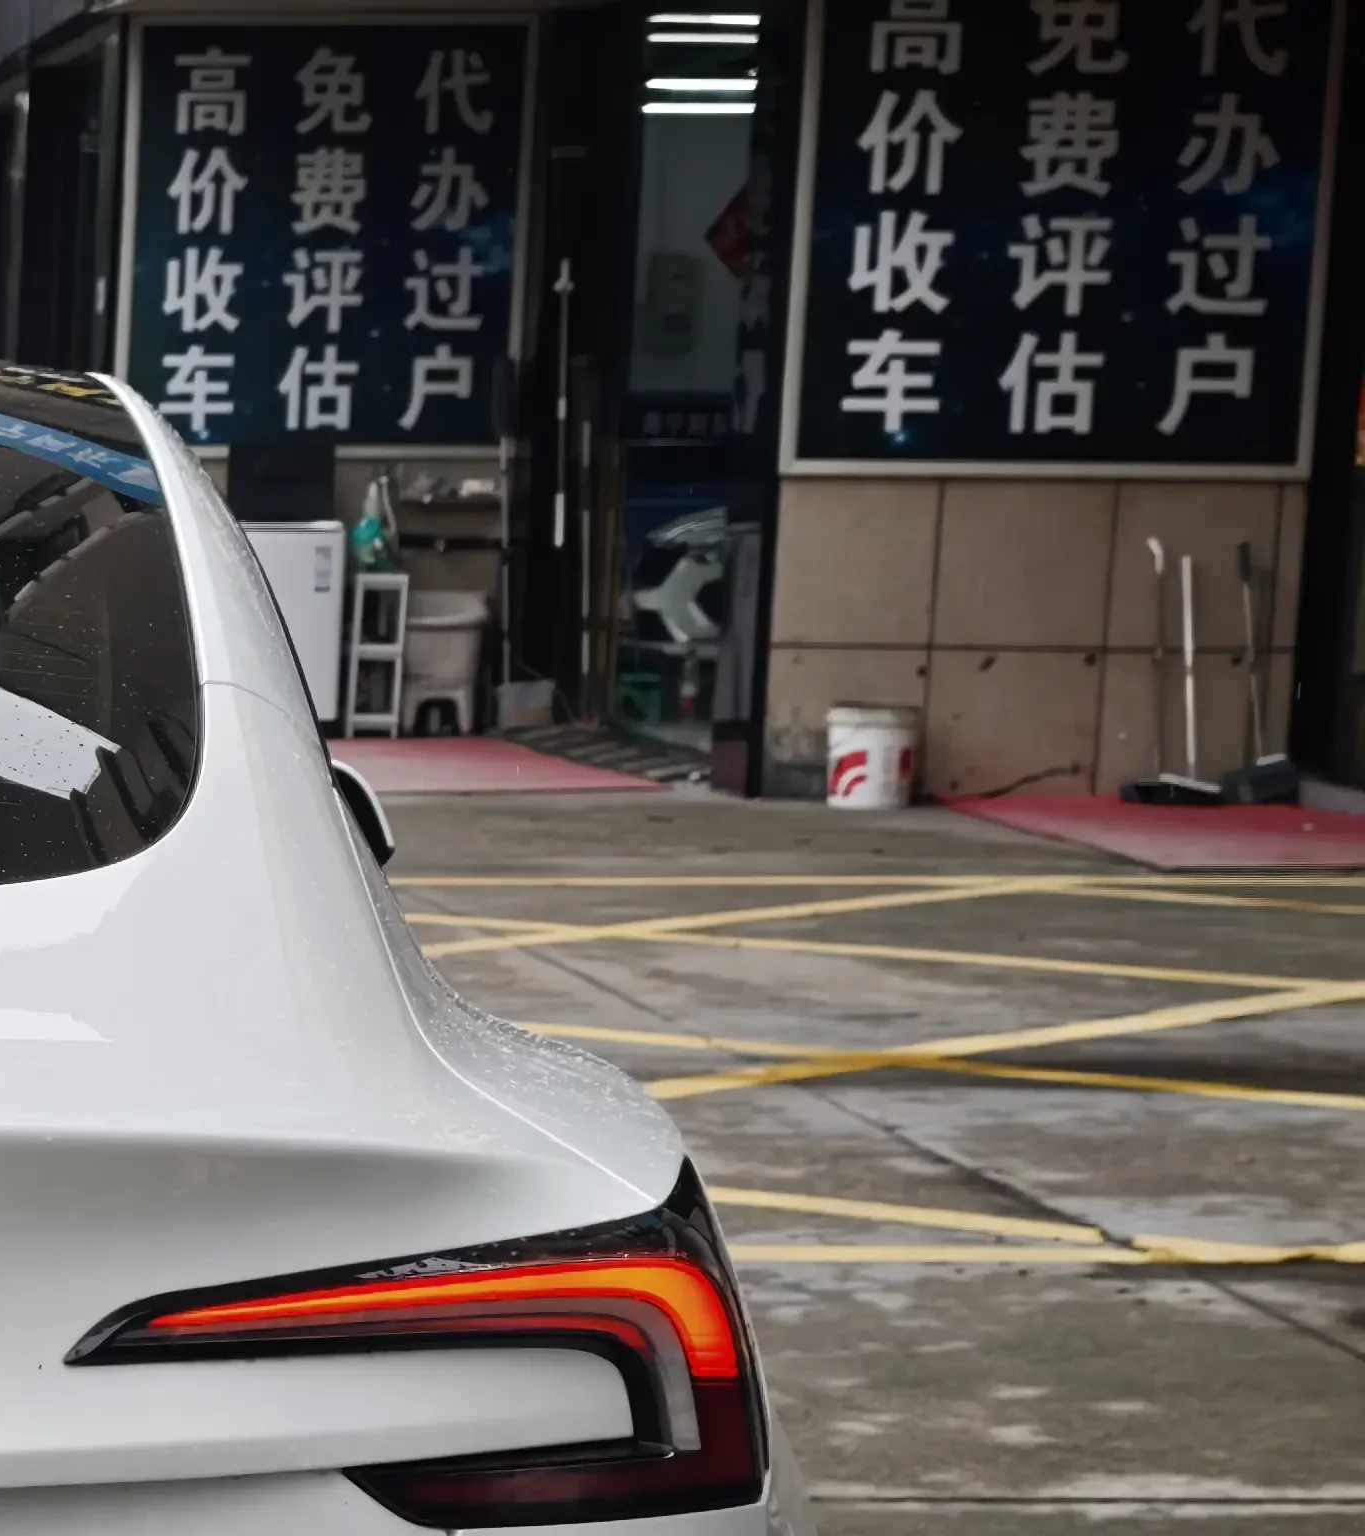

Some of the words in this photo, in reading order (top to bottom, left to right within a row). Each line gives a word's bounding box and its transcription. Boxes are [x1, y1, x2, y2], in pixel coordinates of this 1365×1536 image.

[159, 48, 252, 429] 高价收车
[278, 46, 373, 431] 免费评估
[399, 48, 493, 431] 代办过户
[840, 0, 963, 433] 高价收车
[999, 0, 1128, 435] 免费评估
[1156, 0, 1289, 436] 代办过户
